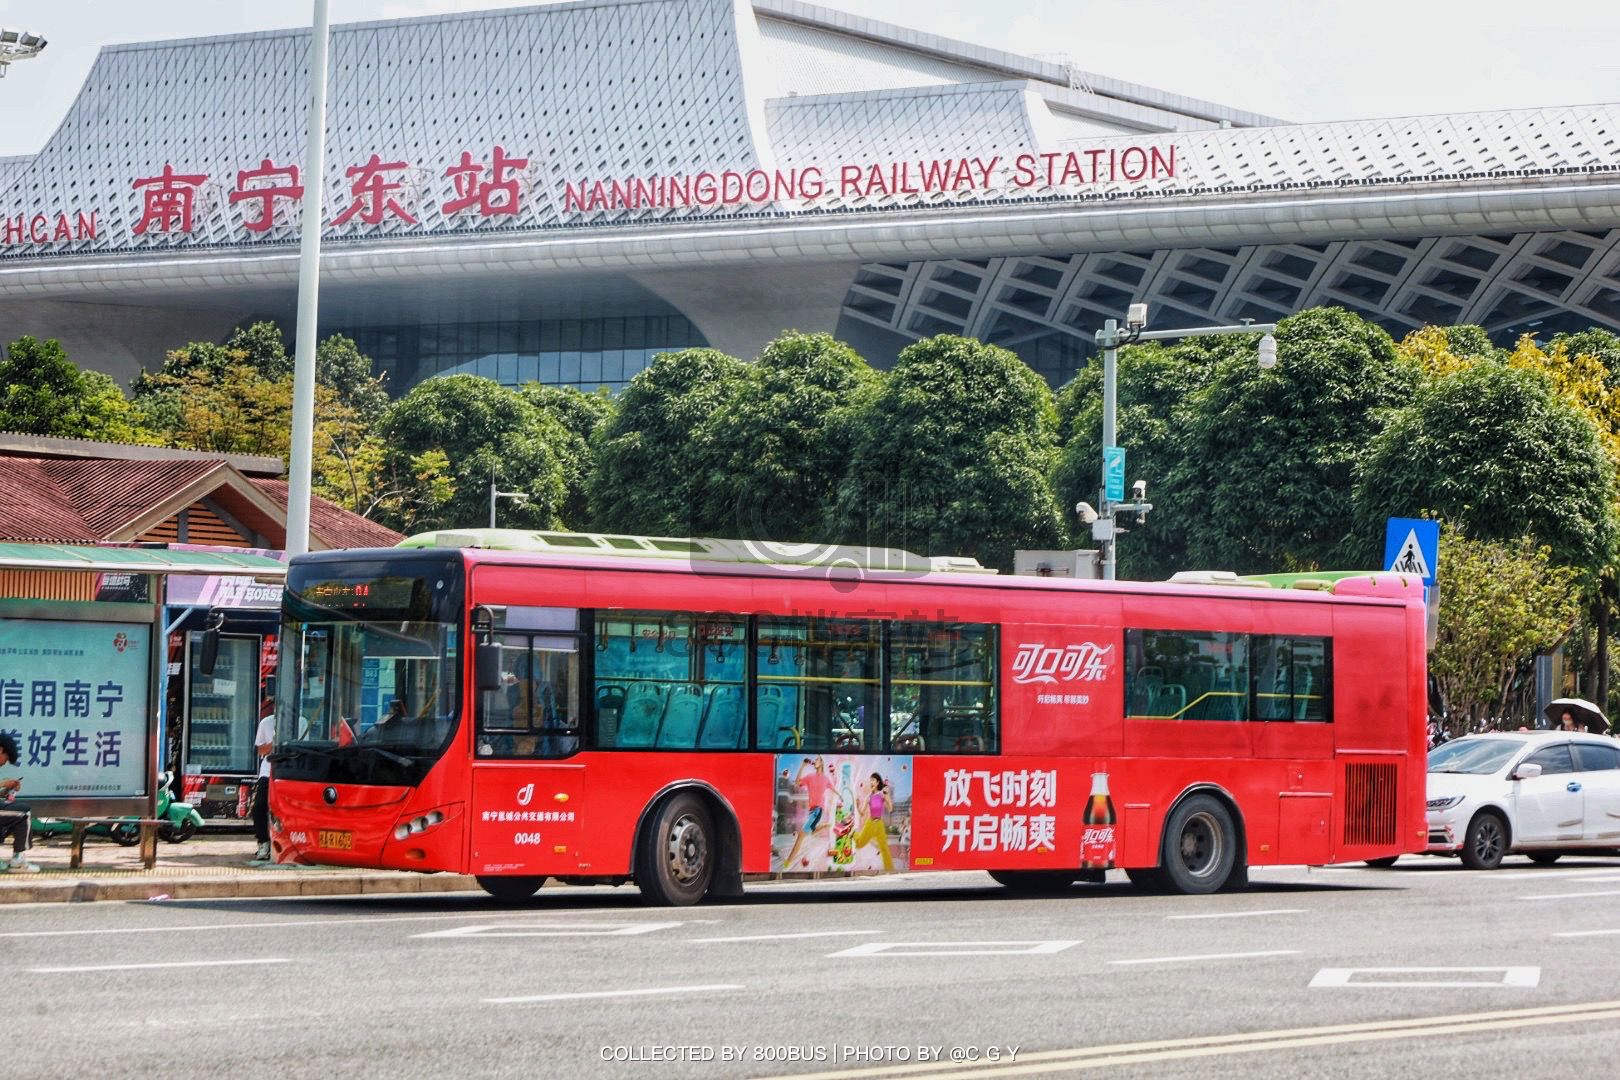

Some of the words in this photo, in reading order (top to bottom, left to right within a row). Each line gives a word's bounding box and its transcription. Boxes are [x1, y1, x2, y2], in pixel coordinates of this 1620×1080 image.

[132, 145, 529, 235] 南宁东站
[564, 166, 824, 212] NANNINGDONG
[840, 156, 1000, 197] RAILWAY
[1012, 144, 1175, 188] STATION
[1012, 641, 1113, 684] 可口可乐
[0, 679, 124, 718] 信用南宁
[943, 768, 1057, 808] 放飞时刻
[514, 832, 541, 845] 0048
[941, 813, 1056, 853] 开启畅爽
